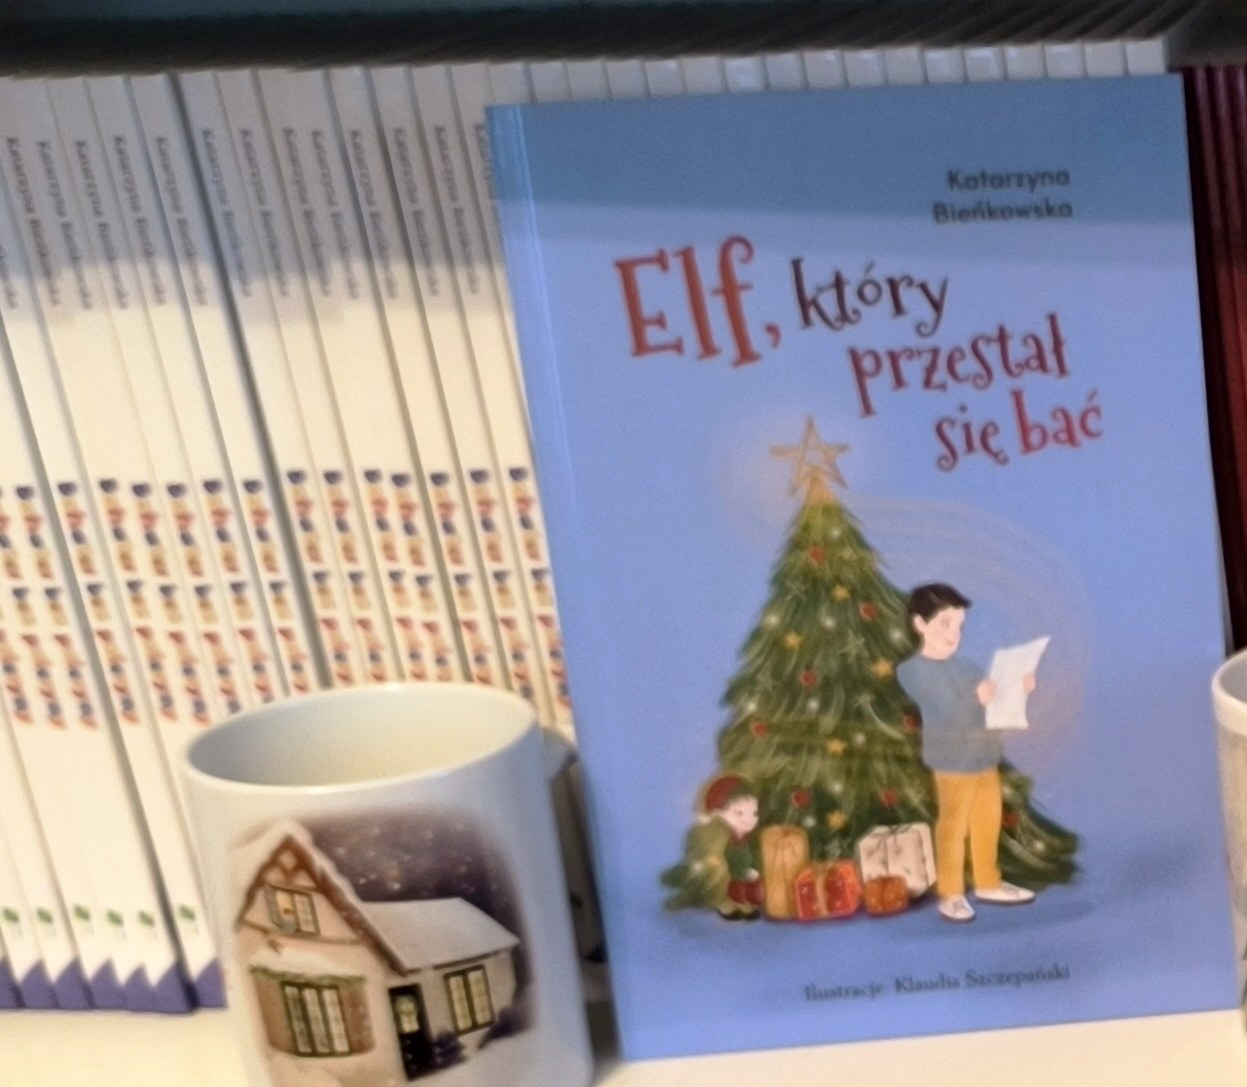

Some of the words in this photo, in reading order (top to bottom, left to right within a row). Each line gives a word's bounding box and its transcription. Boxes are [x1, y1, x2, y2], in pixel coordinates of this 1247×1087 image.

[946, 167, 1071, 194] Katarzyna
[932, 197, 1074, 225] Bieńkowska
[614, 235, 782, 368] Elf,
[790, 256, 948, 337] który
[848, 311, 1070, 418] przestał
[934, 404, 1010, 472] się
[1011, 389, 1106, 456] bać
[894, 967, 961, 996] Klaudia
[963, 962, 1072, 989] Szczepański
